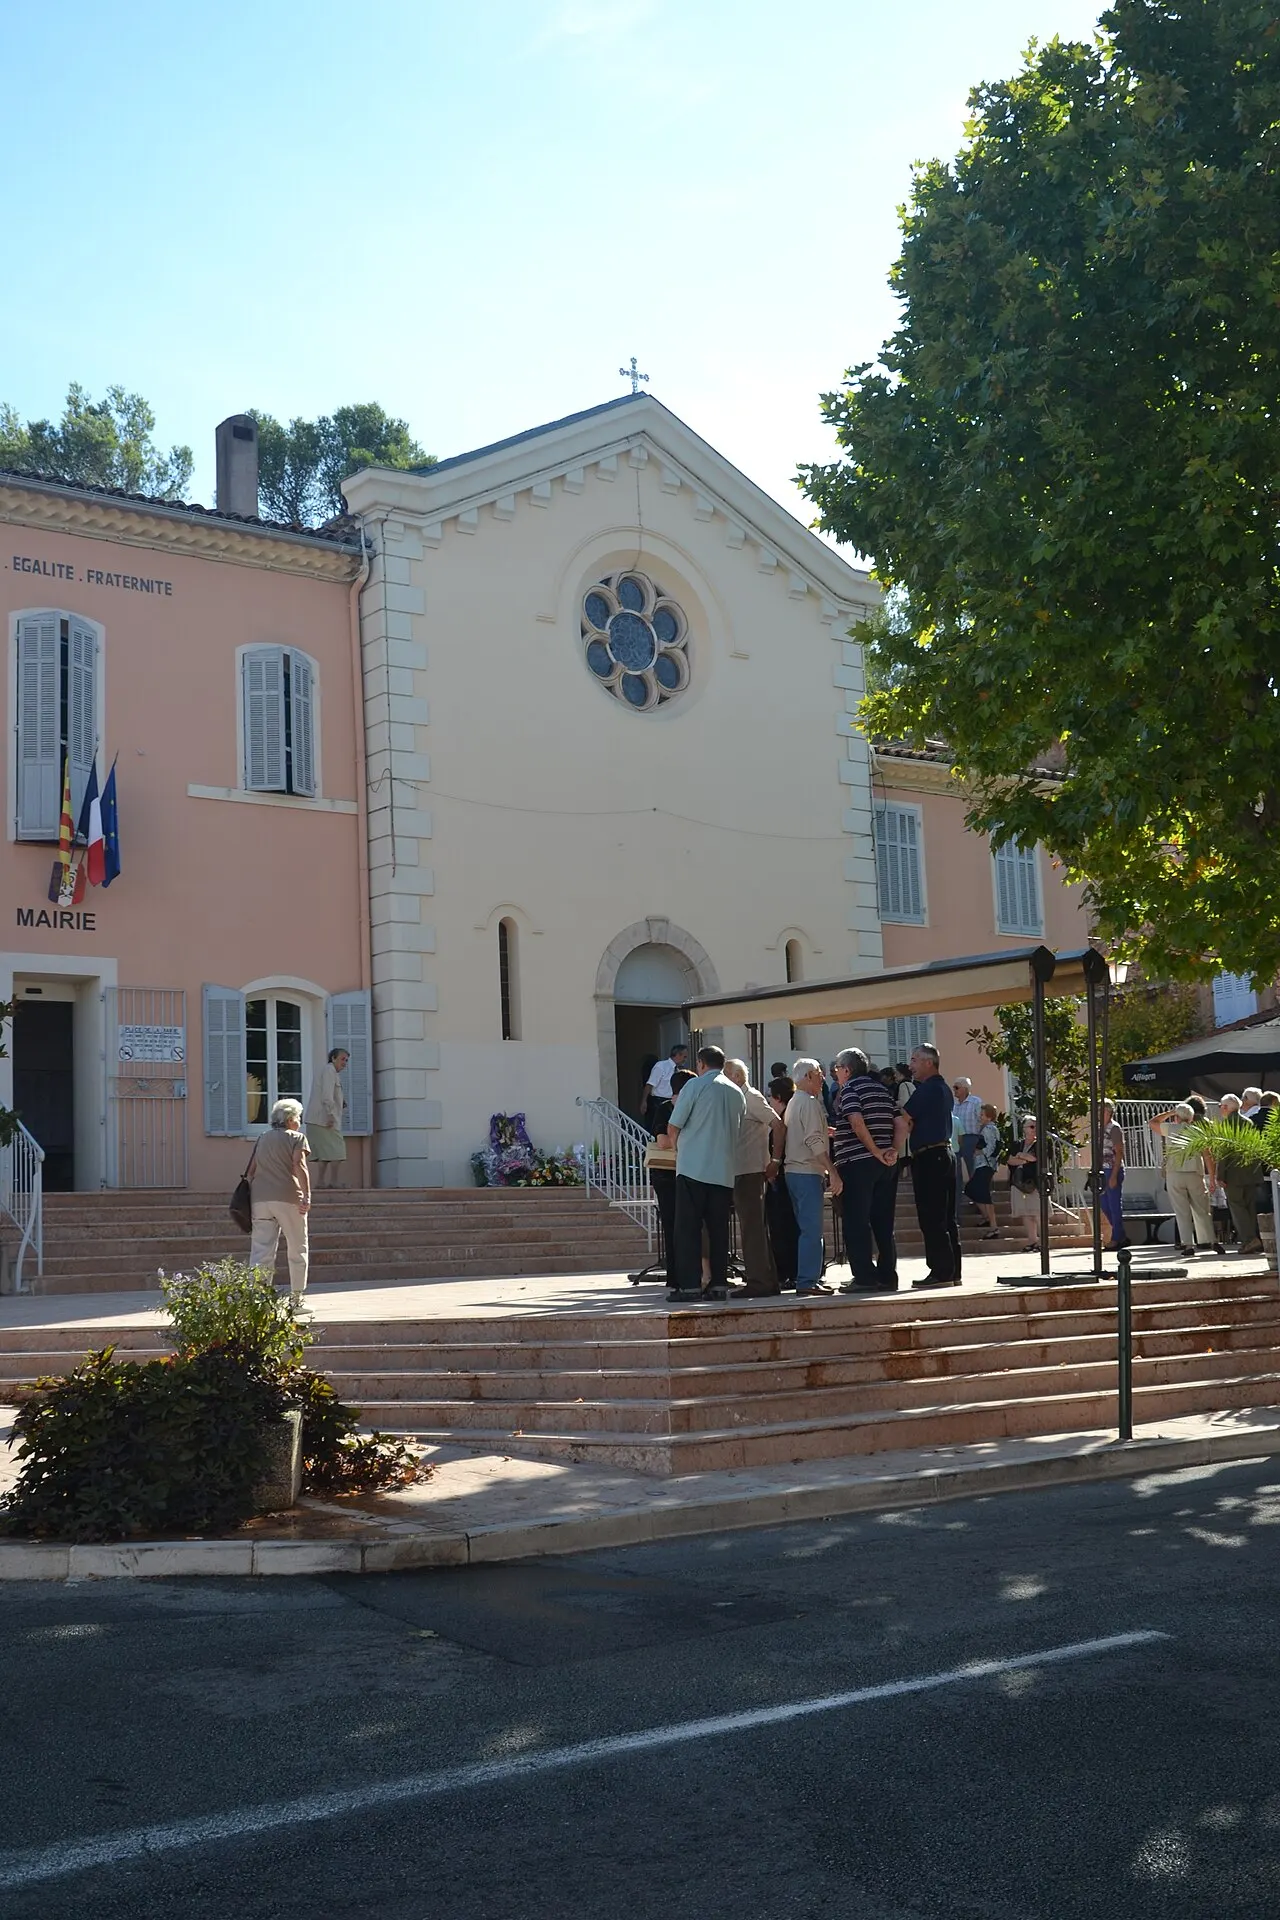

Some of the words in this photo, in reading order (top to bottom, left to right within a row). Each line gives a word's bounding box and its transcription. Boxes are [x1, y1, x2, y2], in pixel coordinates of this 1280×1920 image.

[13, 556, 74, 580] EGALITE
[87, 569, 173, 596] FRATERNITE
[16, 908, 96, 931] MAIRIE
